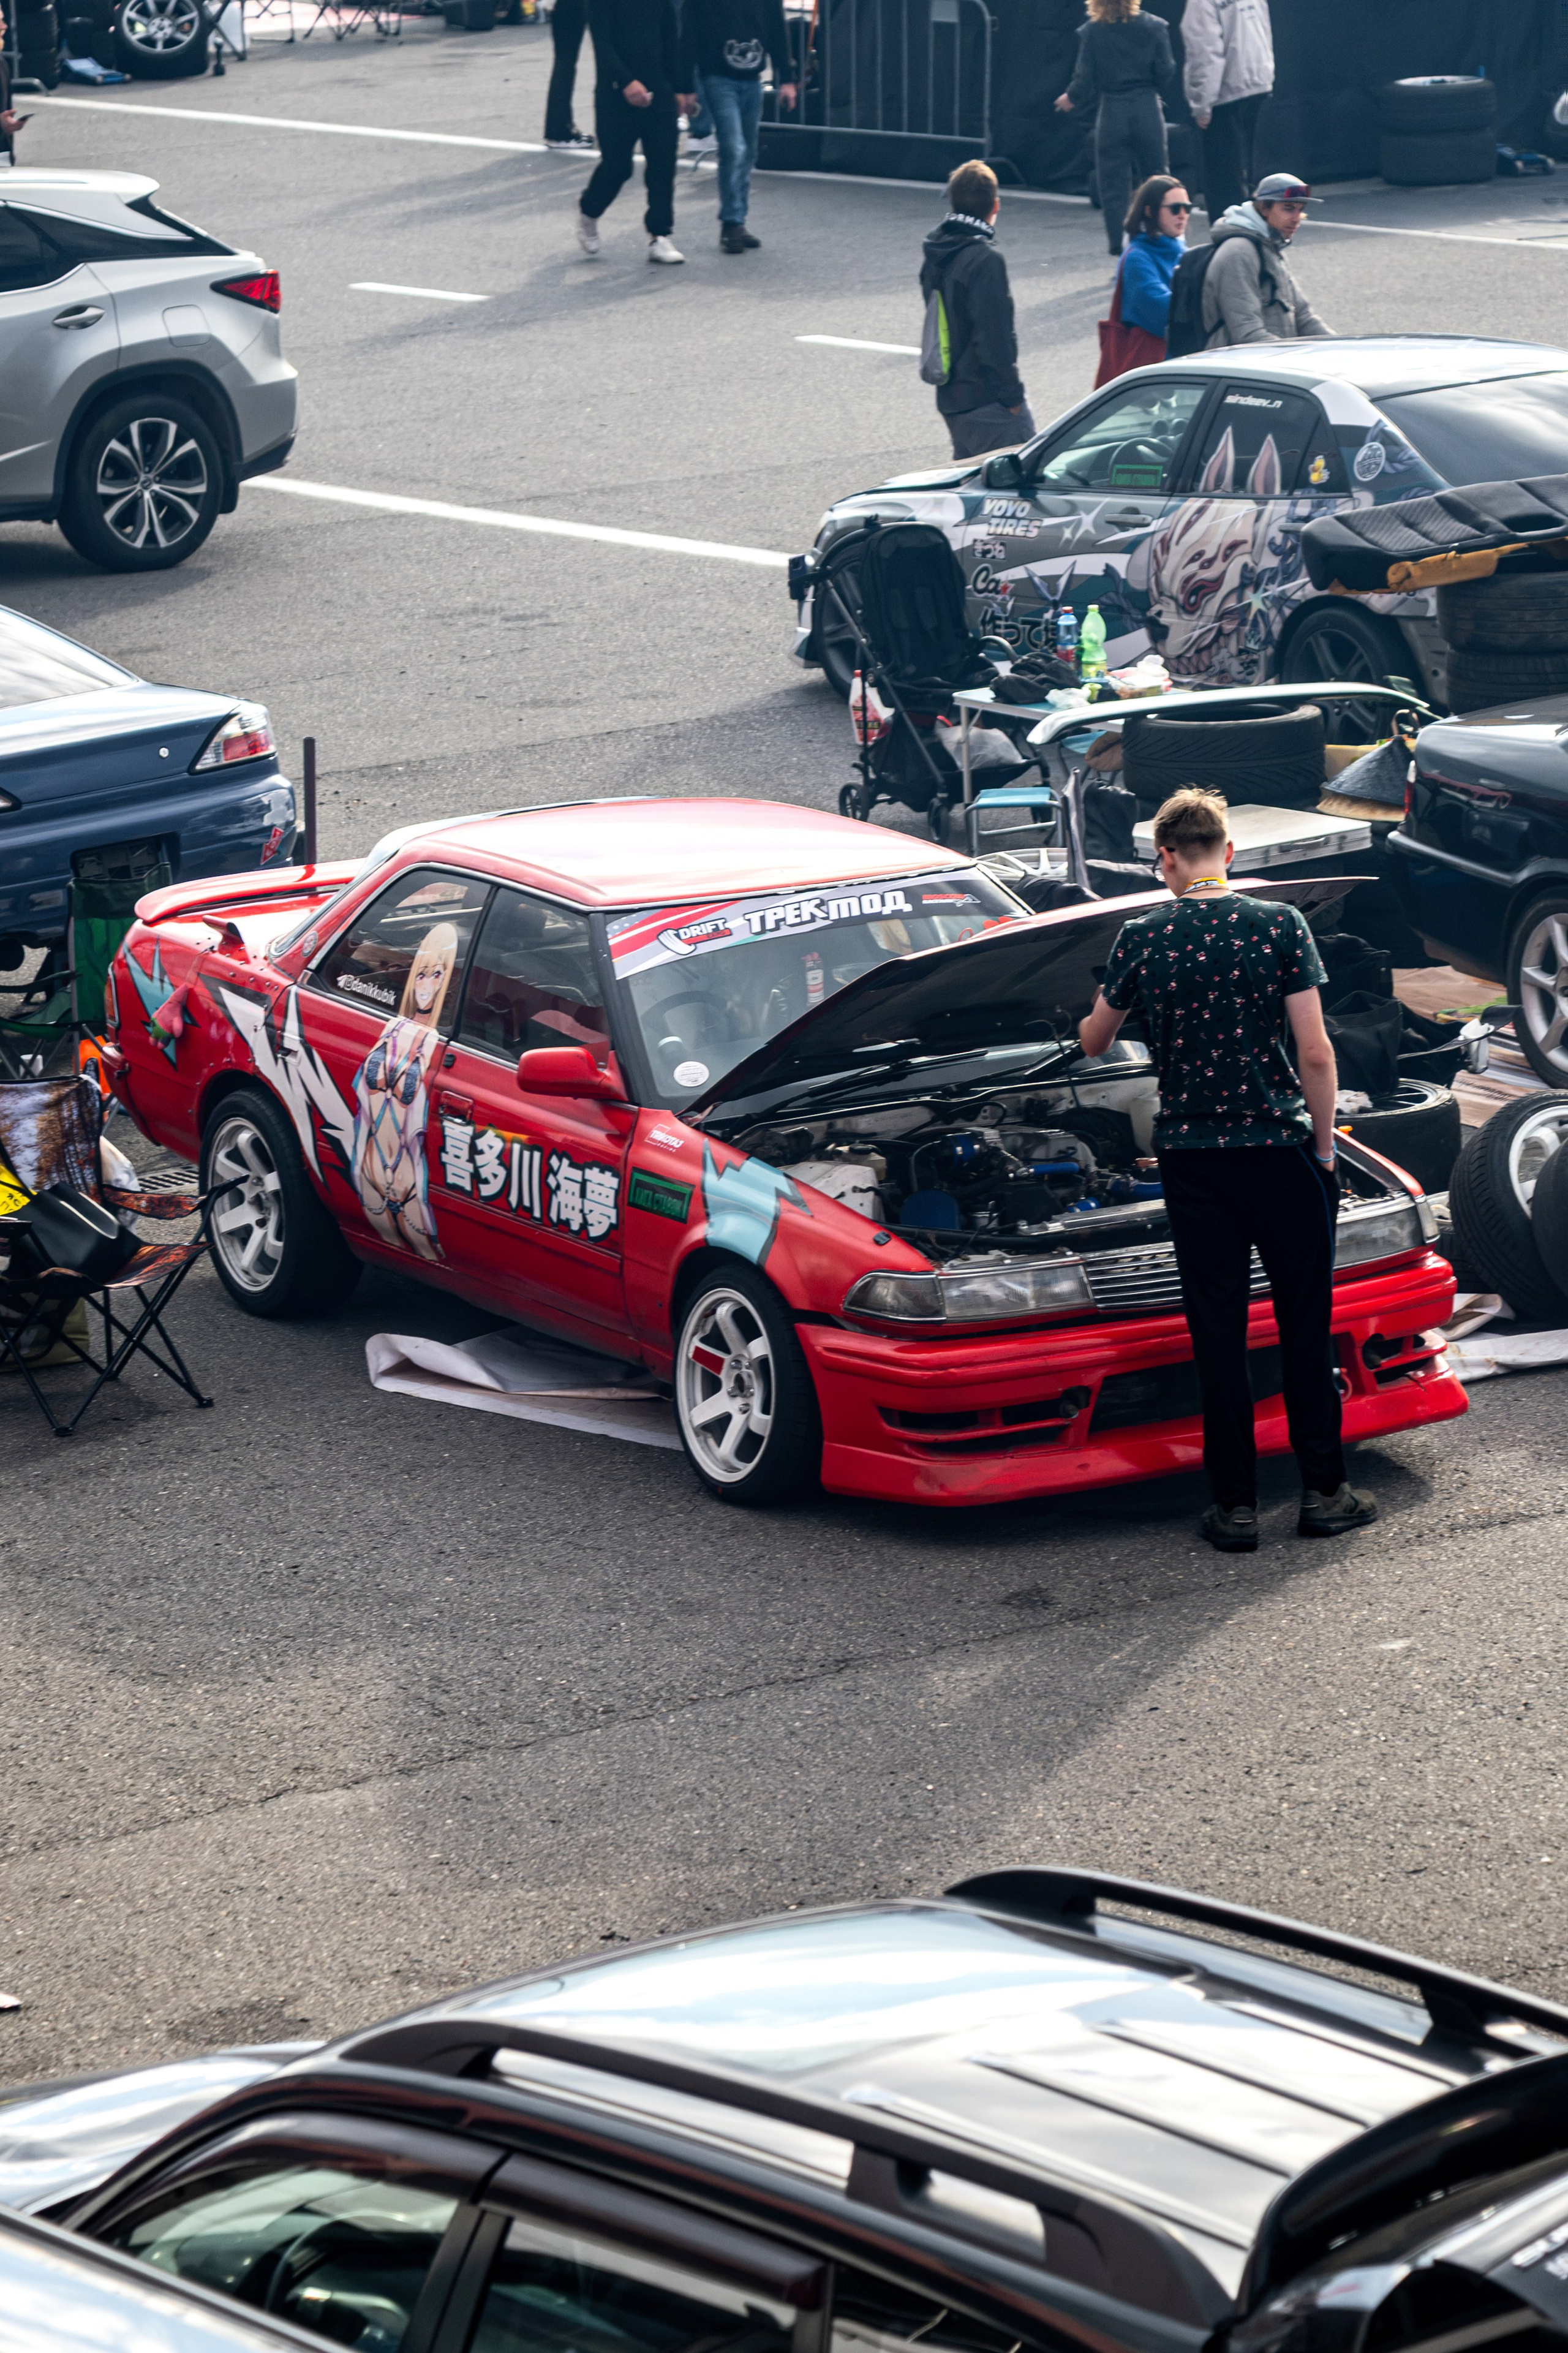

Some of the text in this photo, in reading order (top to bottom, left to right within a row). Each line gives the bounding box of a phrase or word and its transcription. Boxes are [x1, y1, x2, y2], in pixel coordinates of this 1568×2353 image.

[982, 498, 1031, 518] YOYO
[989, 518, 1042, 538] TIRES
[677, 918, 726, 940] DRIFT
